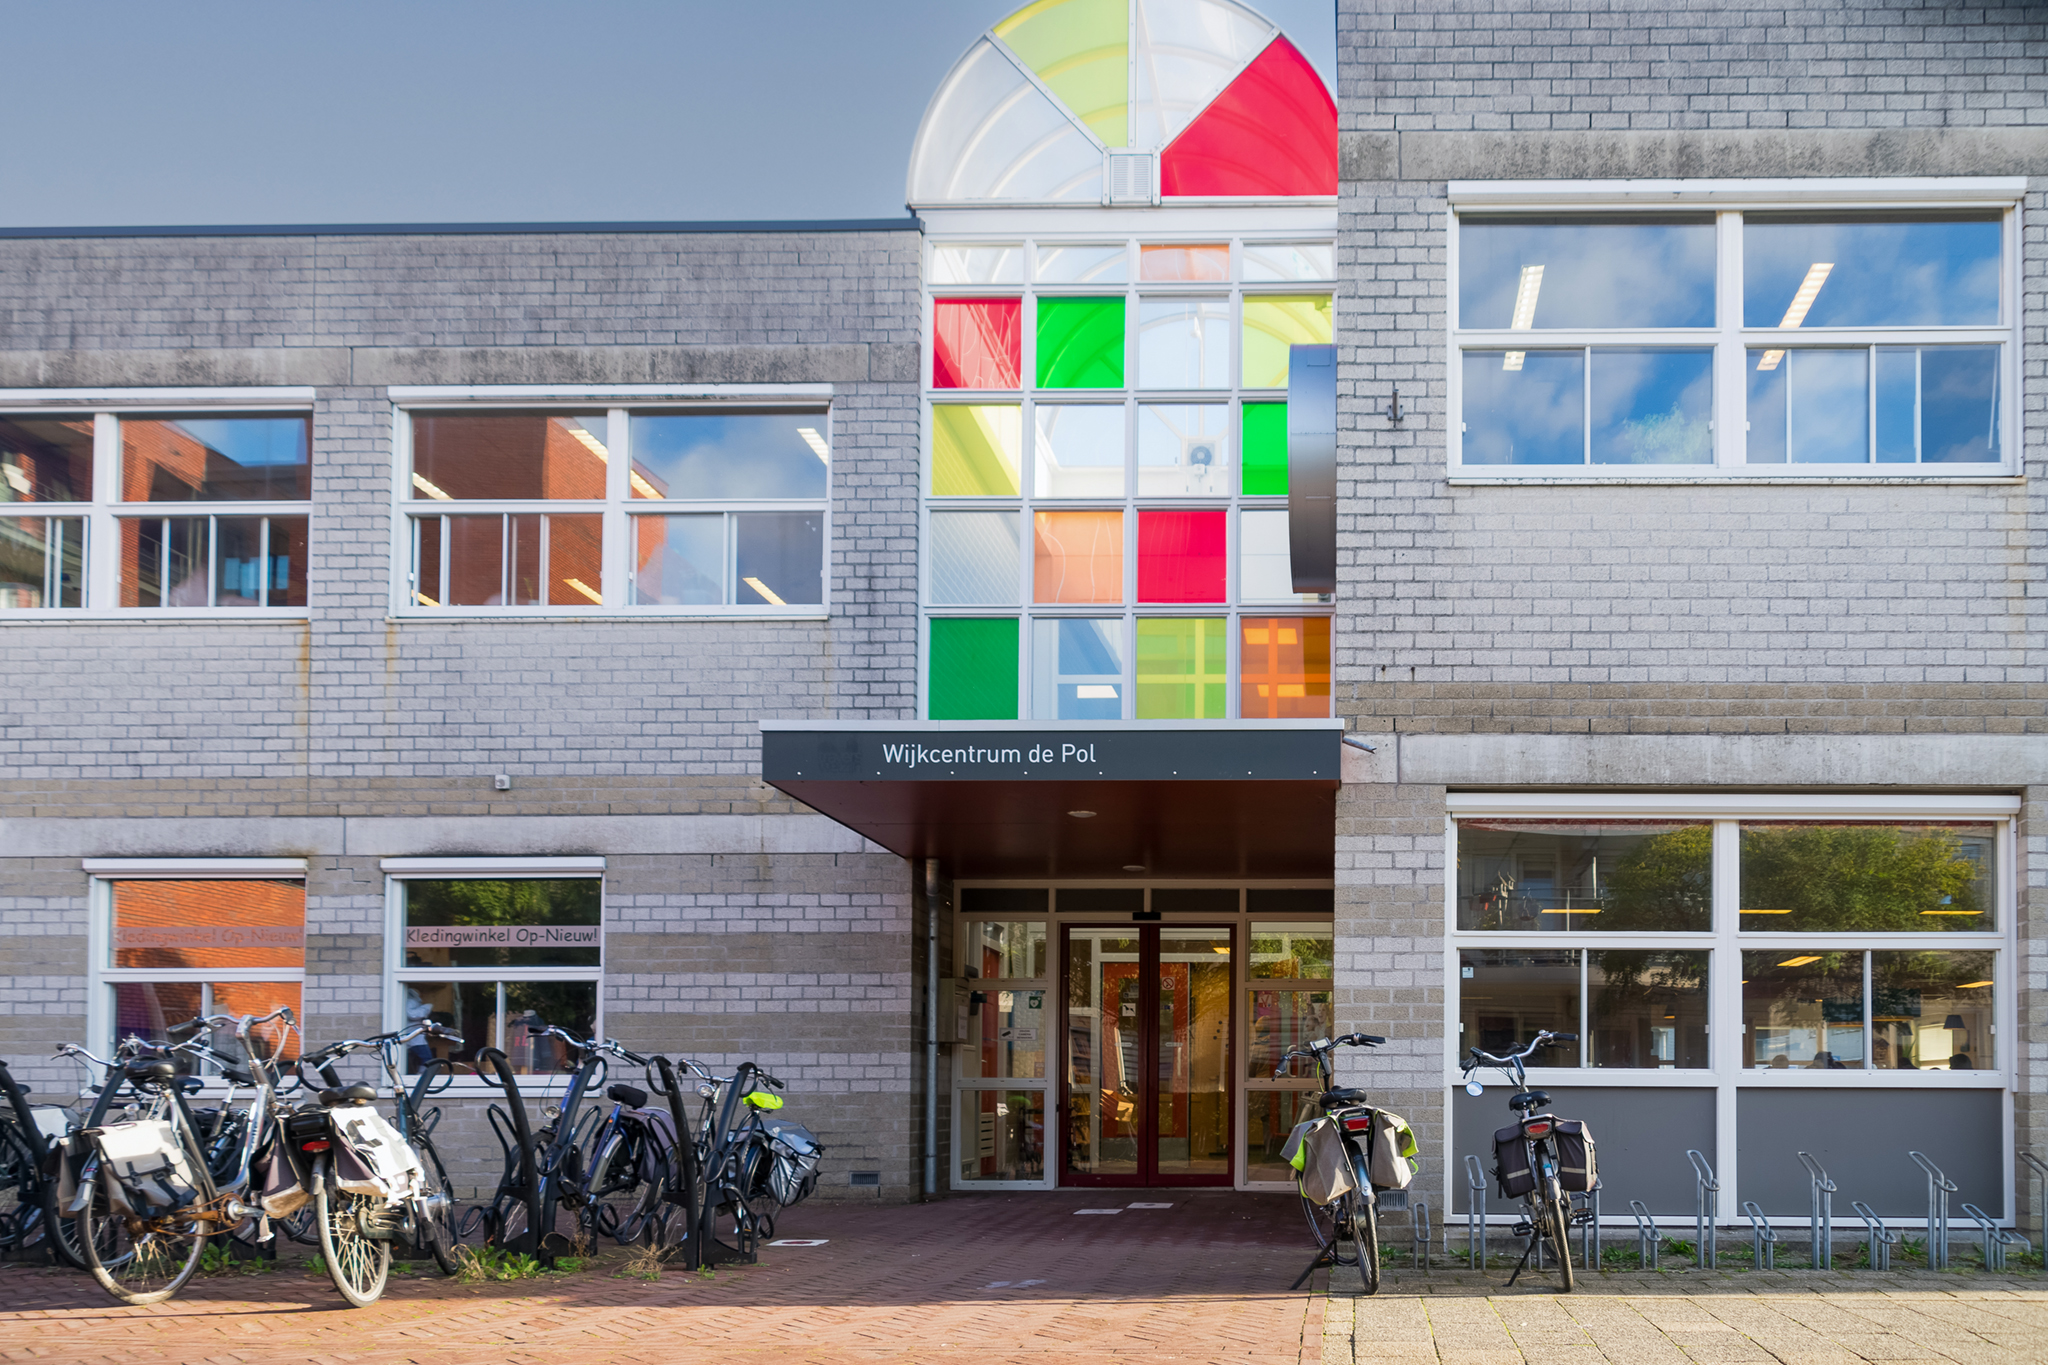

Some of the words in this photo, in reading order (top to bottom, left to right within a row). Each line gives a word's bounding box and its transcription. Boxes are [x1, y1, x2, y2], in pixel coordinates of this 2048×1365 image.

[882, 743, 1021, 769] Wijkcentrum
[1028, 743, 1054, 763] de
[1062, 743, 1097, 763] Pol
[406, 928, 510, 946] Kledingwinkel
[516, 927, 597, 945] Op-Nieuw!
